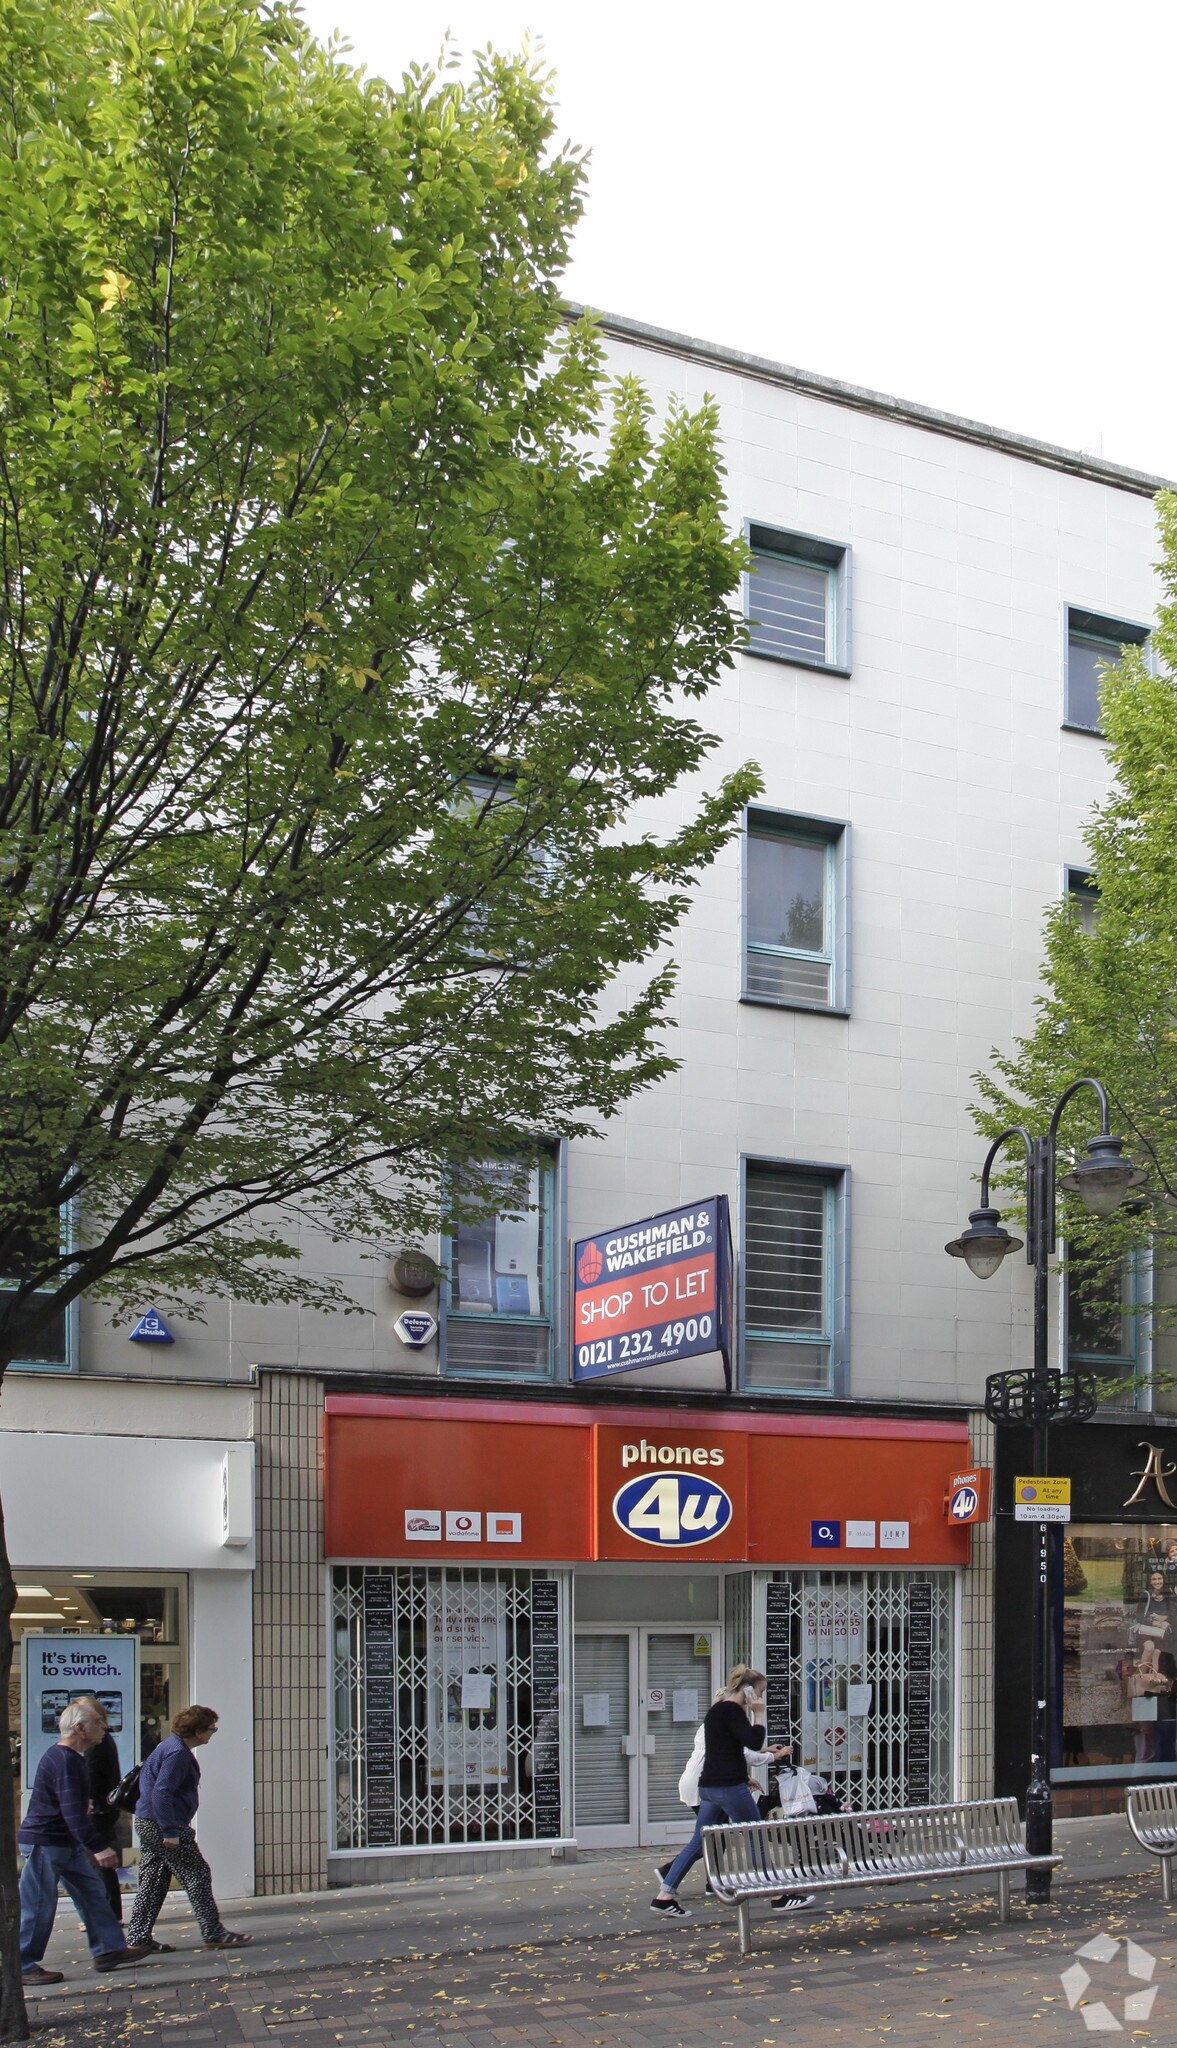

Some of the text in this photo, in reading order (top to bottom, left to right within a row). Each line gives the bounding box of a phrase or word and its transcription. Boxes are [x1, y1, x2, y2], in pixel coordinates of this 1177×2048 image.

[605, 1211, 710, 1256] CUSHMAN &
[581, 1269, 709, 1325] SHOP TO LET
[403, 1318, 431, 1326] Defence
[139, 1328, 166, 1336] Chubb
[578, 1315, 712, 1367] 0121 232 4900
[607, 1348, 679, 1370] www.cushmanwakefield.com
[622, 1439, 725, 1468] phones
[953, 1474, 977, 1487] phones
[628, 1478, 722, 1540] 4u
[952, 1490, 975, 1517] 4u
[808, 1601, 831, 1609] NW
[459, 1615, 501, 1625] maing.
[808, 1619, 847, 1627] GLAXY
[808, 1628, 859, 1636] MNI GOD
[452, 1635, 488, 1643] sevic.
[42, 1651, 107, 1664] It's time
[42, 1664, 121, 1676] to switch.
